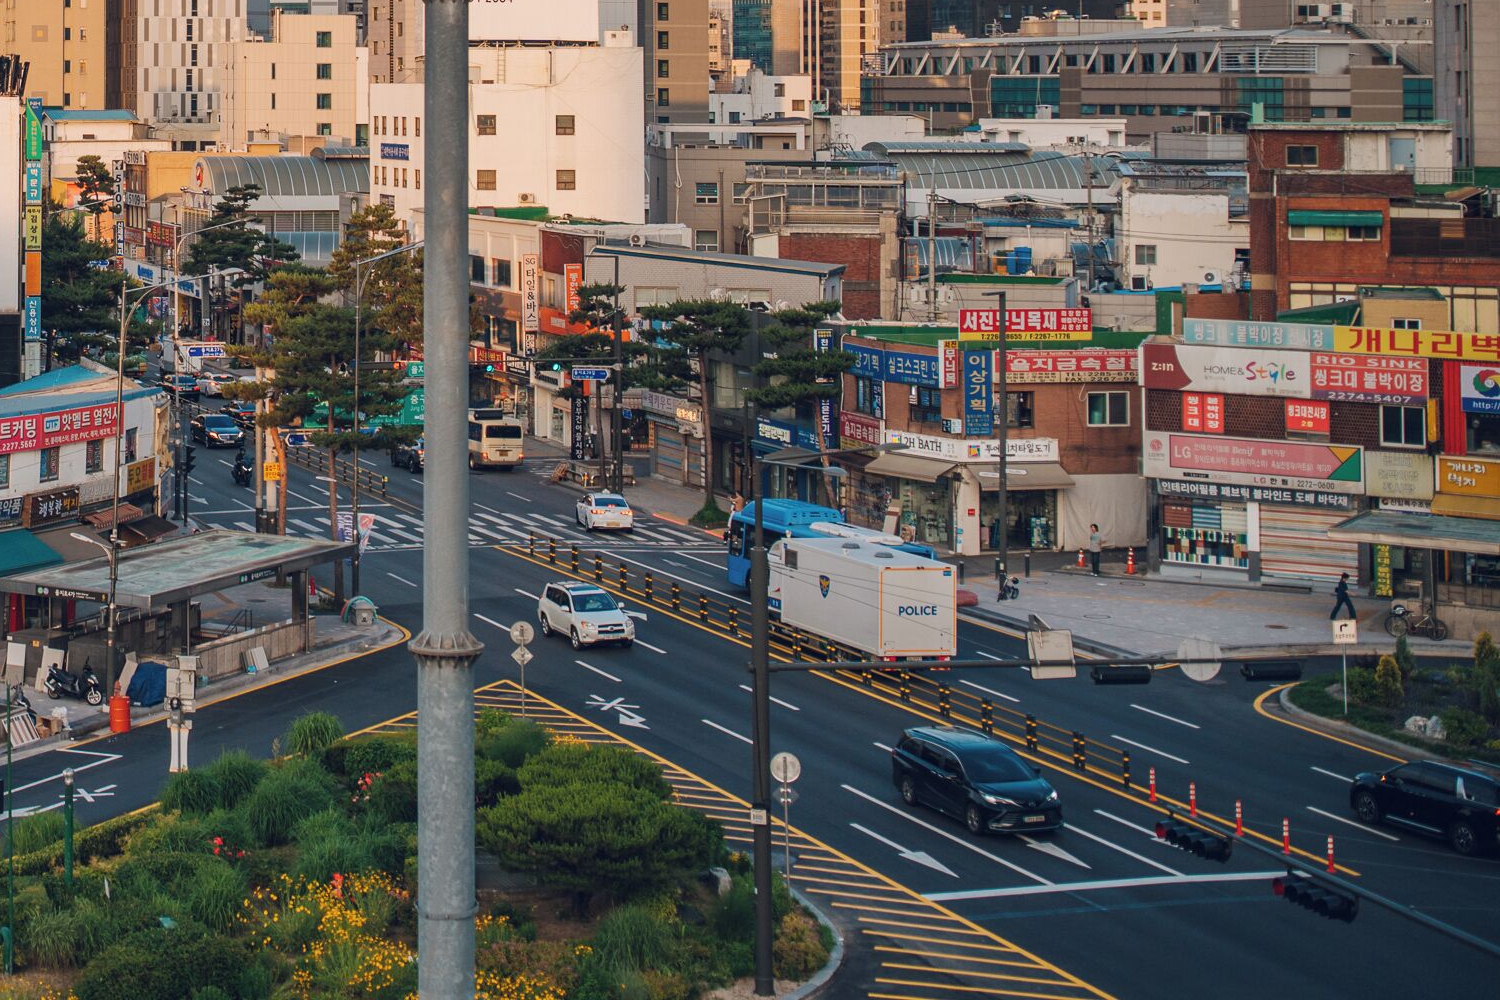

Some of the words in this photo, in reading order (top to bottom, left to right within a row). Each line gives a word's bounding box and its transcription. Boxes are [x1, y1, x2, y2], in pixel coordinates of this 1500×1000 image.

[526, 268, 537, 323] 타일&바스
[29, 300, 37, 334] 신용상사
[981, 332, 1023, 340] T:2268655
[855, 352, 879, 372] 상기획
[888, 357, 928, 378] 실크스크린
[1316, 355, 1356, 365] RIO
[1367, 358, 1422, 369] SINK
[968, 354, 988, 412] 이상기획
[1314, 369, 1357, 389] 씽크대
[1363, 371, 1423, 392] 붙박이장
[1327, 391, 1411, 403] 2274-5407
[62, 410, 91, 432] 핫멜트
[1287, 405, 1327, 419] 씽크대전시장
[575, 398, 583, 459] 중부건어물시장
[844, 421, 879, 445] 을지금속철물
[918, 436, 942, 452] BATH
[1174, 445, 1192, 459] LG
[1447, 462, 1486, 474] 개나리
[1297, 479, 1335, 490] 2272-0600
[1447, 474, 1476, 487] 벽지
[1161, 481, 1218, 496] 인테리어필름
[1221, 486, 1250, 498] 패브릭
[1253, 488, 1292, 501] 블라인드
[1295, 491, 1315, 504] 도배
[1318, 493, 1348, 507] 바닥재
[899, 606, 937, 616] POLICE
